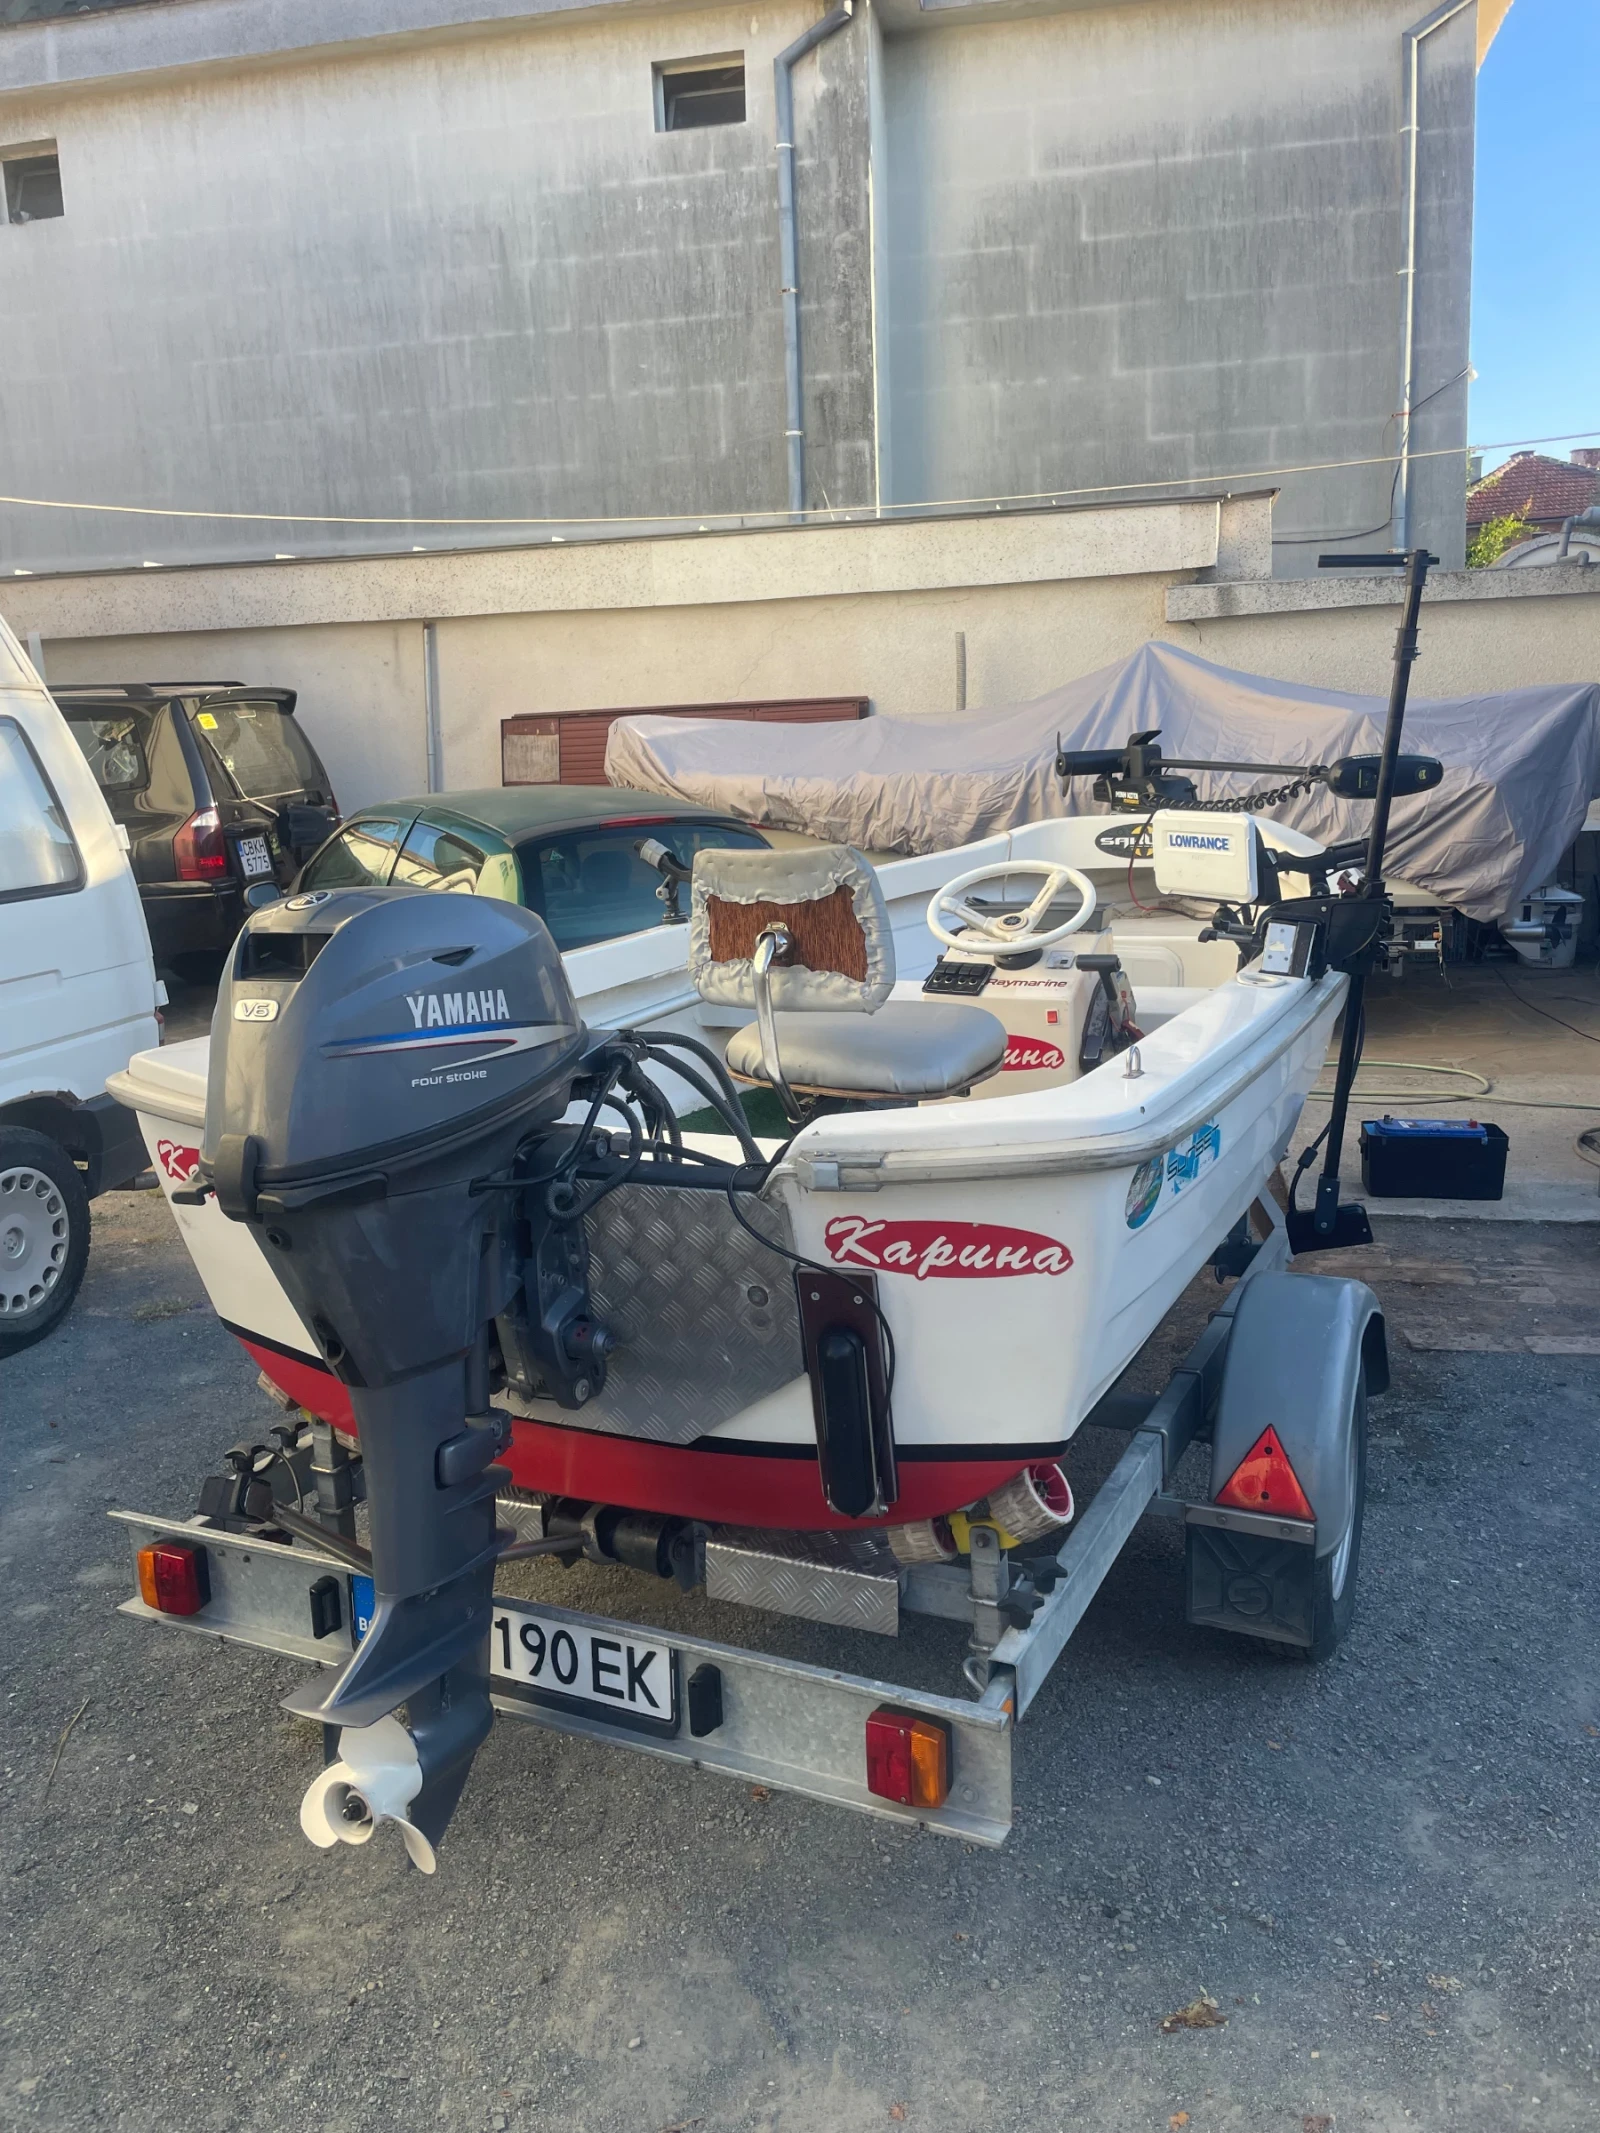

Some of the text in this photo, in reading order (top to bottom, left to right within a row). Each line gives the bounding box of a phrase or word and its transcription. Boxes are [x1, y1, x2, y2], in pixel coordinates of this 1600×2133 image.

[1169, 834, 1229, 850] LOWRANCE
[987, 978, 1067, 988] Raymarine
[242, 1003, 271, 1018] V6
[406, 989, 510, 1028] YAMAHA
[1003, 1048, 1063, 1068] ина
[828, 1219, 1069, 1277] Карина
[358, 1616, 371, 1631] B
[495, 1617, 660, 1709] 190 EK
